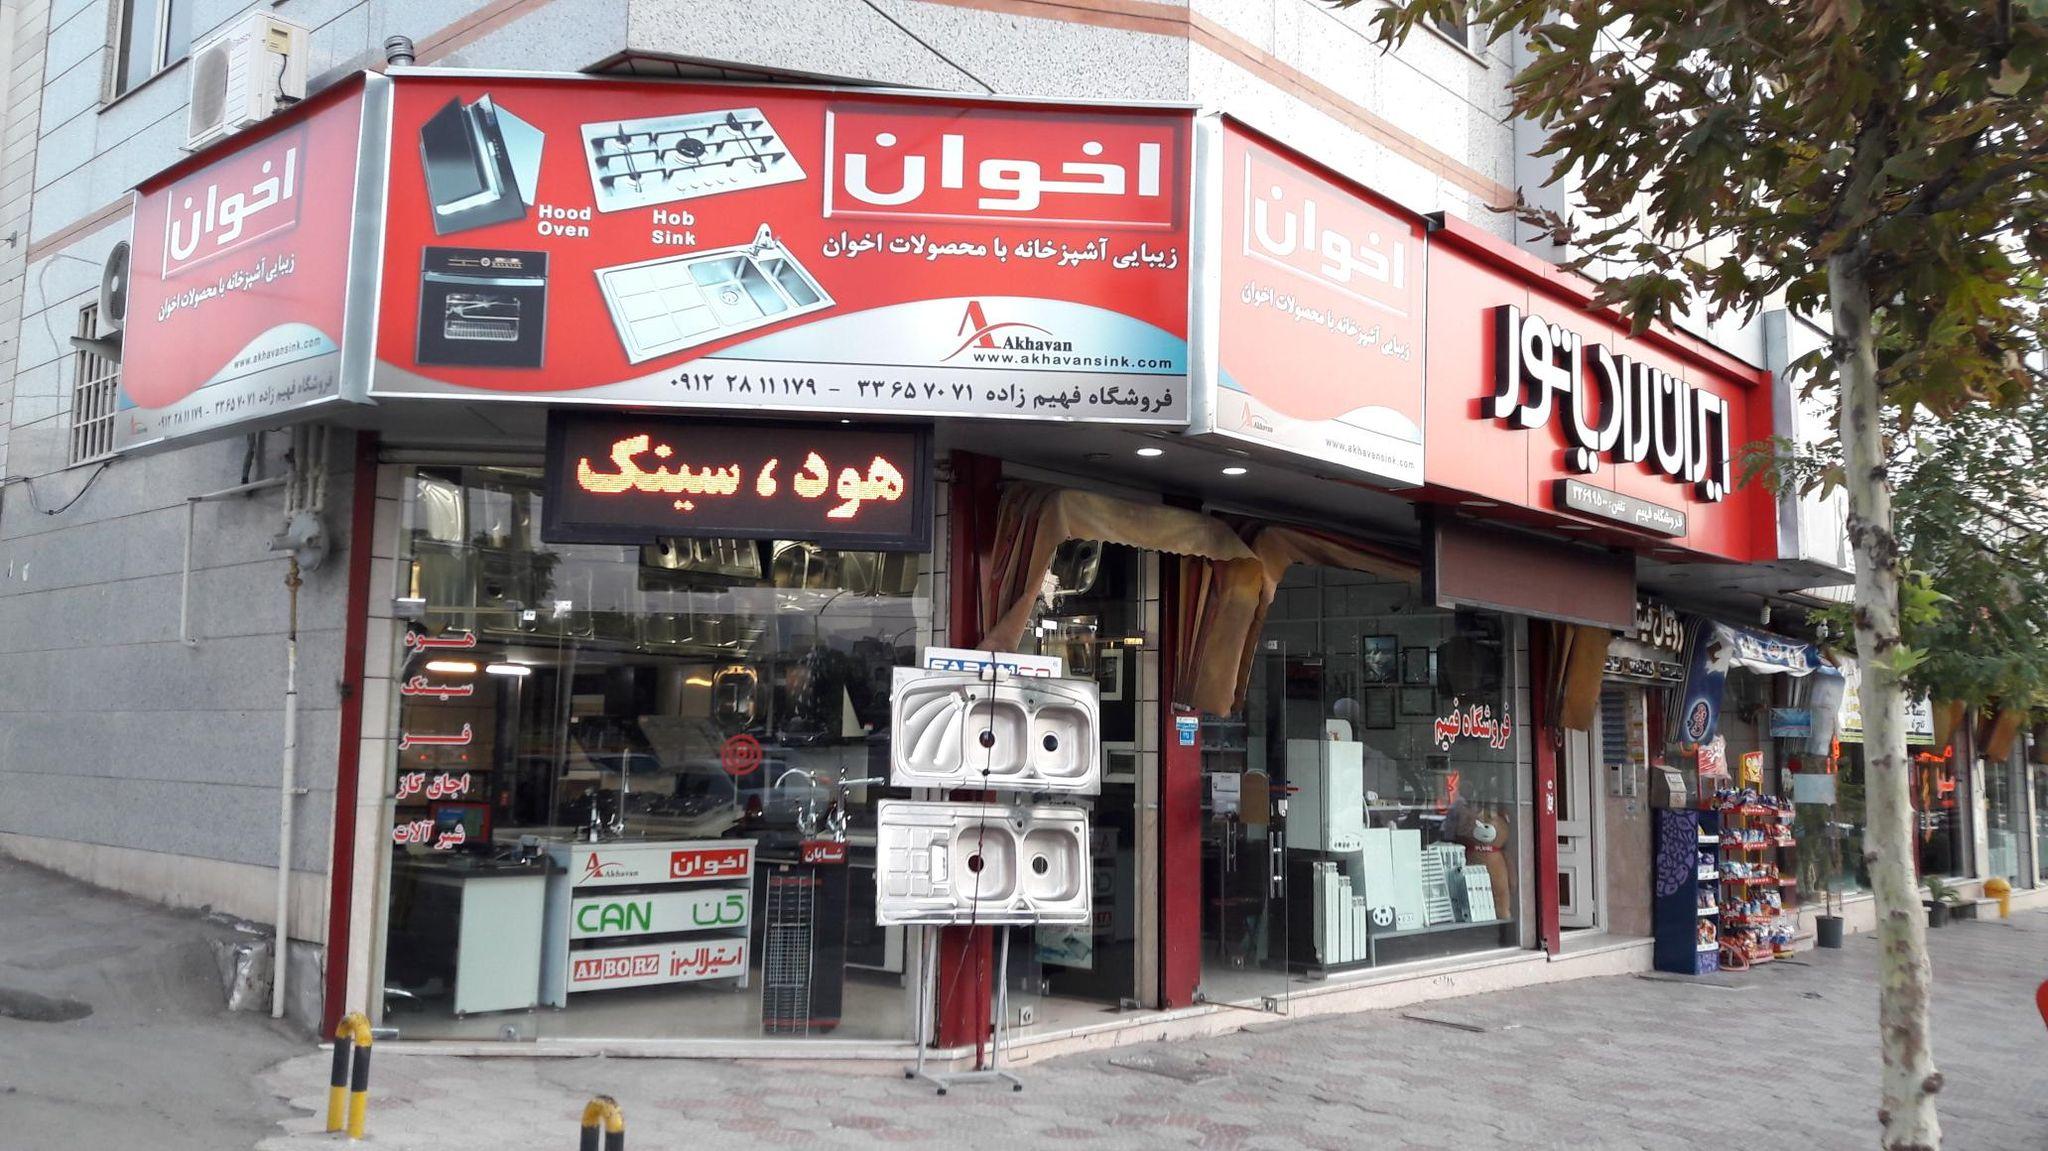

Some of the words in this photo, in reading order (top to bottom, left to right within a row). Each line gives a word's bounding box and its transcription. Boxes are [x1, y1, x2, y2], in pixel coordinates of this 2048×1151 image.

[843, 132, 1161, 212] اخوان
[170, 147, 297, 261] اخوان
[538, 204, 592, 222] Hood
[537, 221, 590, 237] Oven
[652, 209, 696, 227] Hob
[651, 229, 697, 246] Sink
[822, 230, 884, 259] اخوان
[888, 234, 988, 262] محصولات
[1253, 184, 1406, 289] اخوان
[993, 237, 1009, 264] با
[1113, 247, 1178, 270] زیبایی
[158, 292, 181, 322] اخوان
[1003, 336, 1073, 353] Akhavan
[973, 353, 1173, 370] www.akhavansink.com
[985, 383, 1027, 409] زاده
[1033, 385, 1083, 410] فهیم
[1088, 384, 1175, 415] فروشگاه
[1494, 304, 1650, 474] رادیاتور
[1649, 366, 1732, 503] ایران
[577, 434, 741, 512] سینک
[405, 630, 477, 651] هود
[400, 676, 474, 700] سینک
[397, 723, 473, 749] فر
[1434, 697, 1461, 752] فهیم
[1462, 701, 1512, 750] فروشگاه
[427, 773, 470, 800] اجاق
[393, 820, 434, 843] آلات
[434, 824, 466, 850] شیر
[673, 852, 745, 876] اخوان
[577, 900, 652, 933] CAN
[574, 954, 659, 982] ALBORZ
